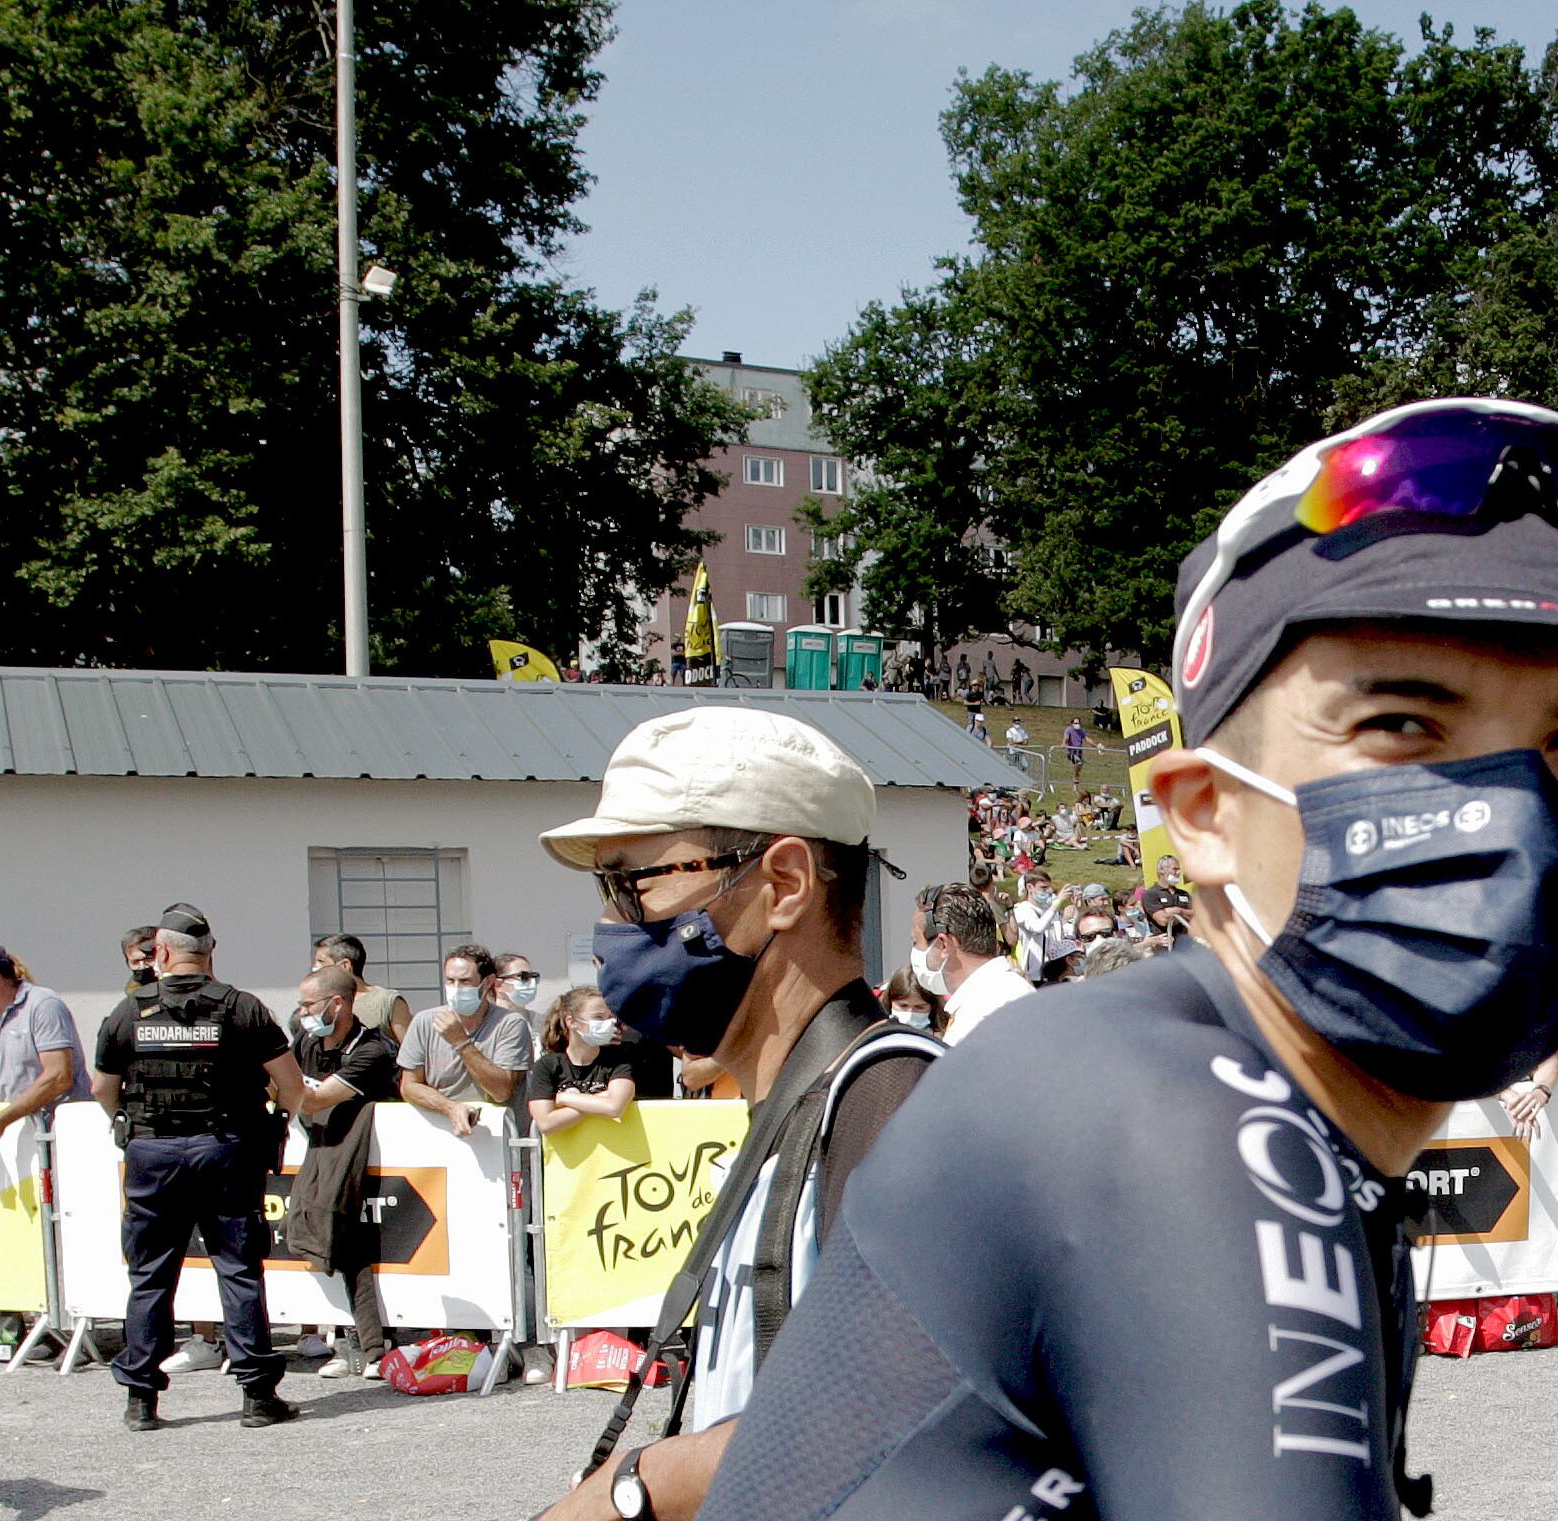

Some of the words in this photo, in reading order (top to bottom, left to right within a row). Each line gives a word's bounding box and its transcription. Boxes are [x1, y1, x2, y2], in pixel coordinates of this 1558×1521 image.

[1129, 730, 1168, 756] PADDOCK
[1381, 810, 1451, 837] INEOS
[137, 1026, 220, 1041] GENDARMERIE
[692, 1186, 715, 1209] de
[586, 1200, 709, 1273] fran
